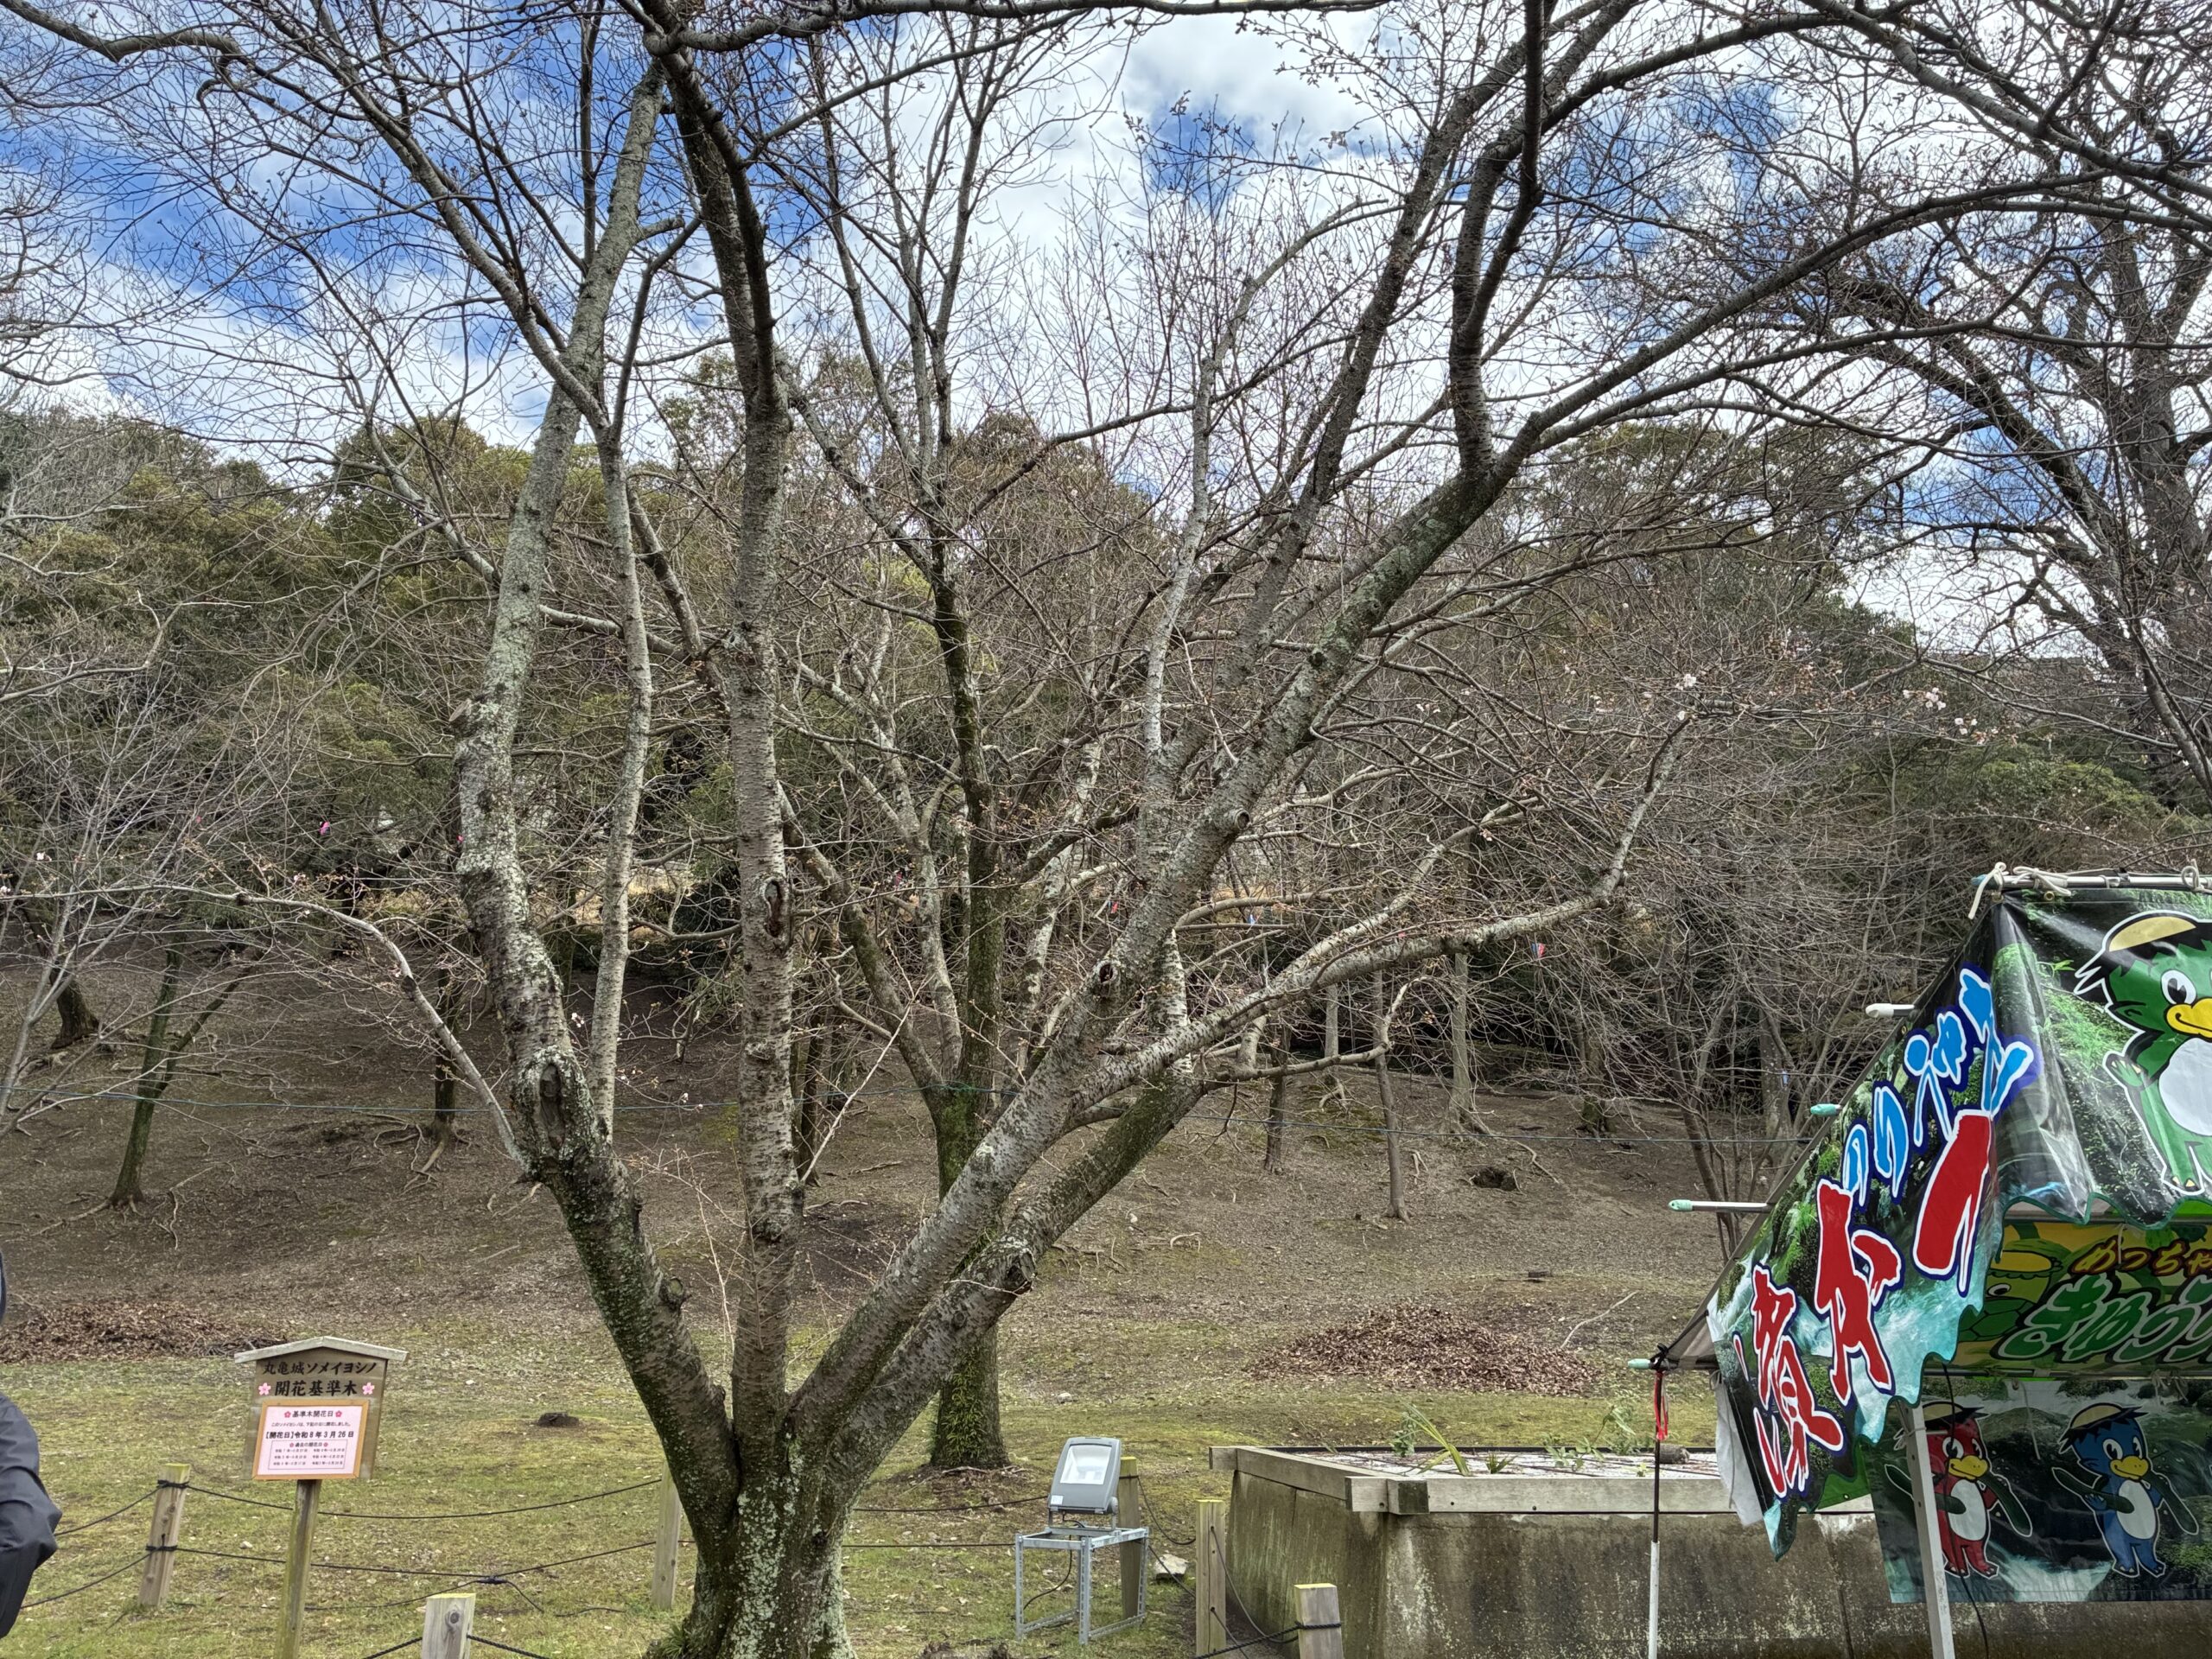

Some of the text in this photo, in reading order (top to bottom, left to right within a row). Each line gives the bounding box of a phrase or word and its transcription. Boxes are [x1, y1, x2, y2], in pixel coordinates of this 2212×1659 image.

[263, 1362, 377, 1375] 丸亀城ソメイヨシノ
[275, 1380, 357, 1396] 開花基準木
